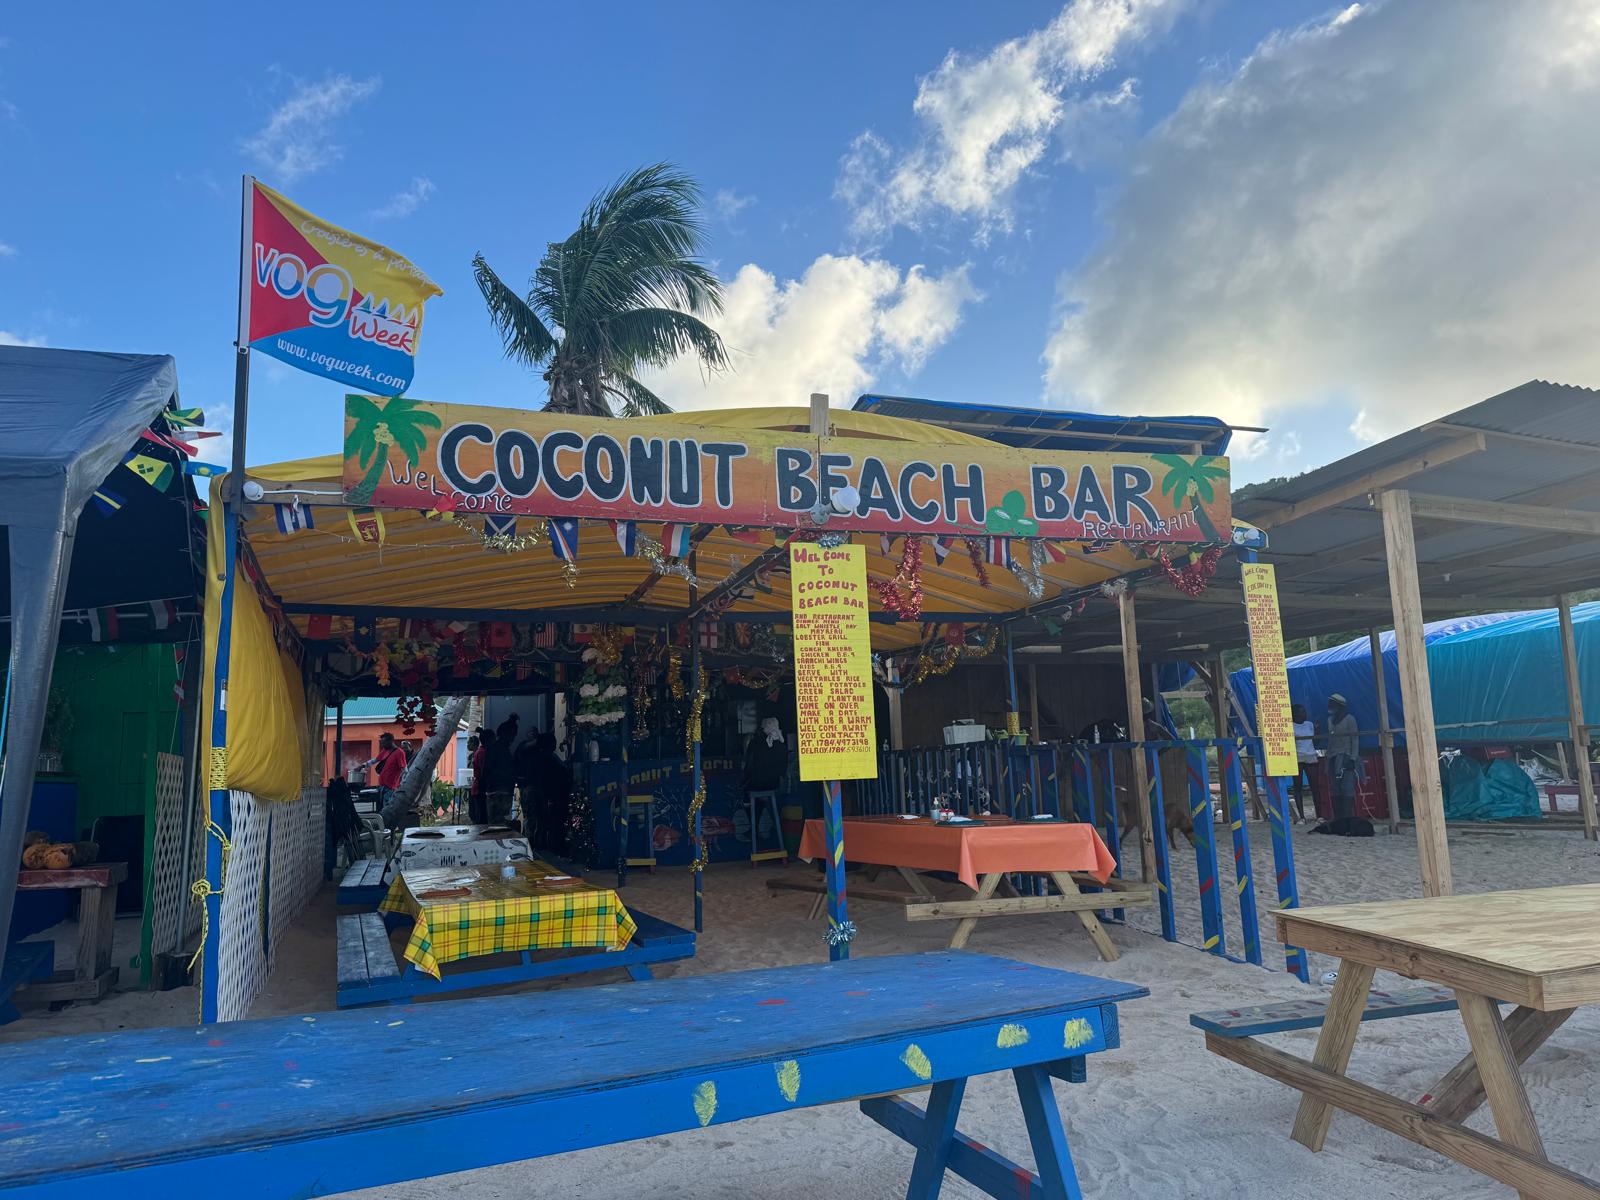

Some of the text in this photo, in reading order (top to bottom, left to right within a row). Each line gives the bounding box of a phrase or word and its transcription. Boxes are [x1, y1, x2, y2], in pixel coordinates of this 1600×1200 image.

[350, 313, 414, 355] Week
[277, 336, 406, 390] www.vogweek.com
[438, 421, 1160, 528] COCONUT BEACH BAR
[798, 580, 858, 593] COCONUT
[799, 595, 865, 609] BEACH BAR
[812, 613, 855, 621] RESTAURANT
[800, 709, 821, 717] MAKE
[823, 716, 835, 724] US
[838, 716, 844, 724] A
[847, 716, 872, 724] WARM
[820, 731, 865, 739] CONTACTS
